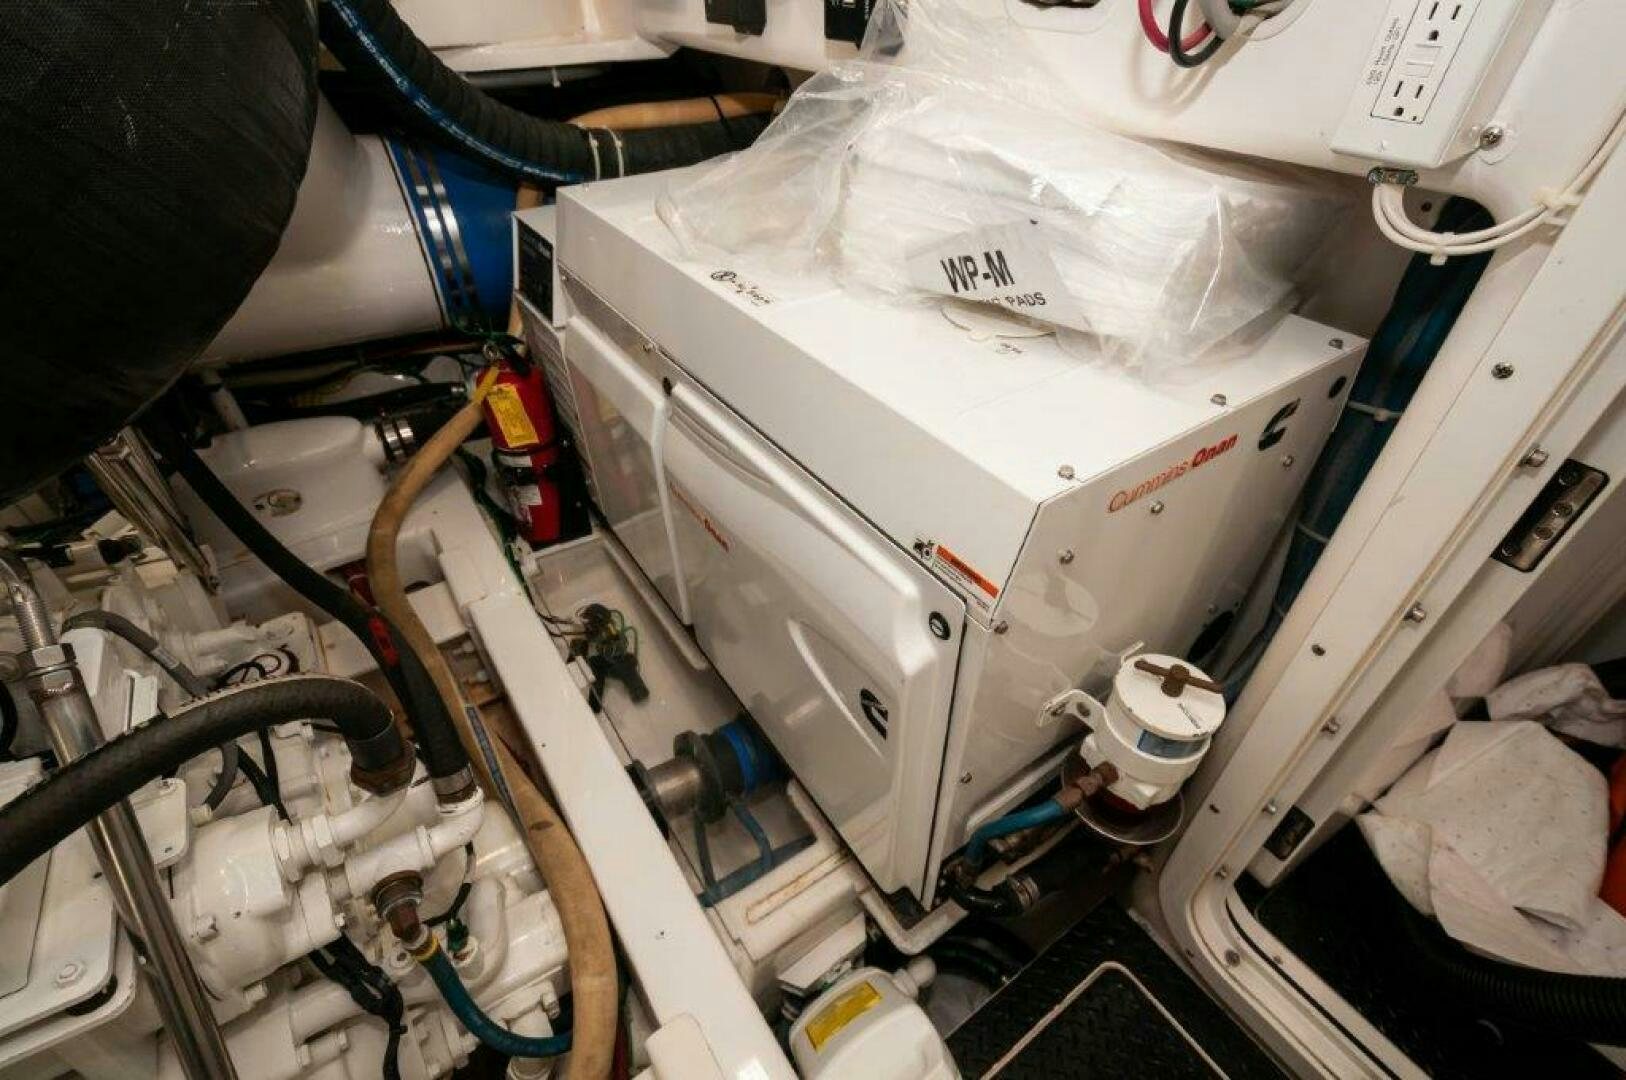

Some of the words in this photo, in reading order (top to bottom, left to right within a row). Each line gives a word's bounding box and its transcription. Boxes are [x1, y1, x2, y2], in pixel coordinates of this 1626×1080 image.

[939, 248, 1015, 293] WP-M
[1005, 292, 1047, 307] PADS
[1108, 461, 1188, 512] Cummins
[1191, 433, 1238, 468] Onan
